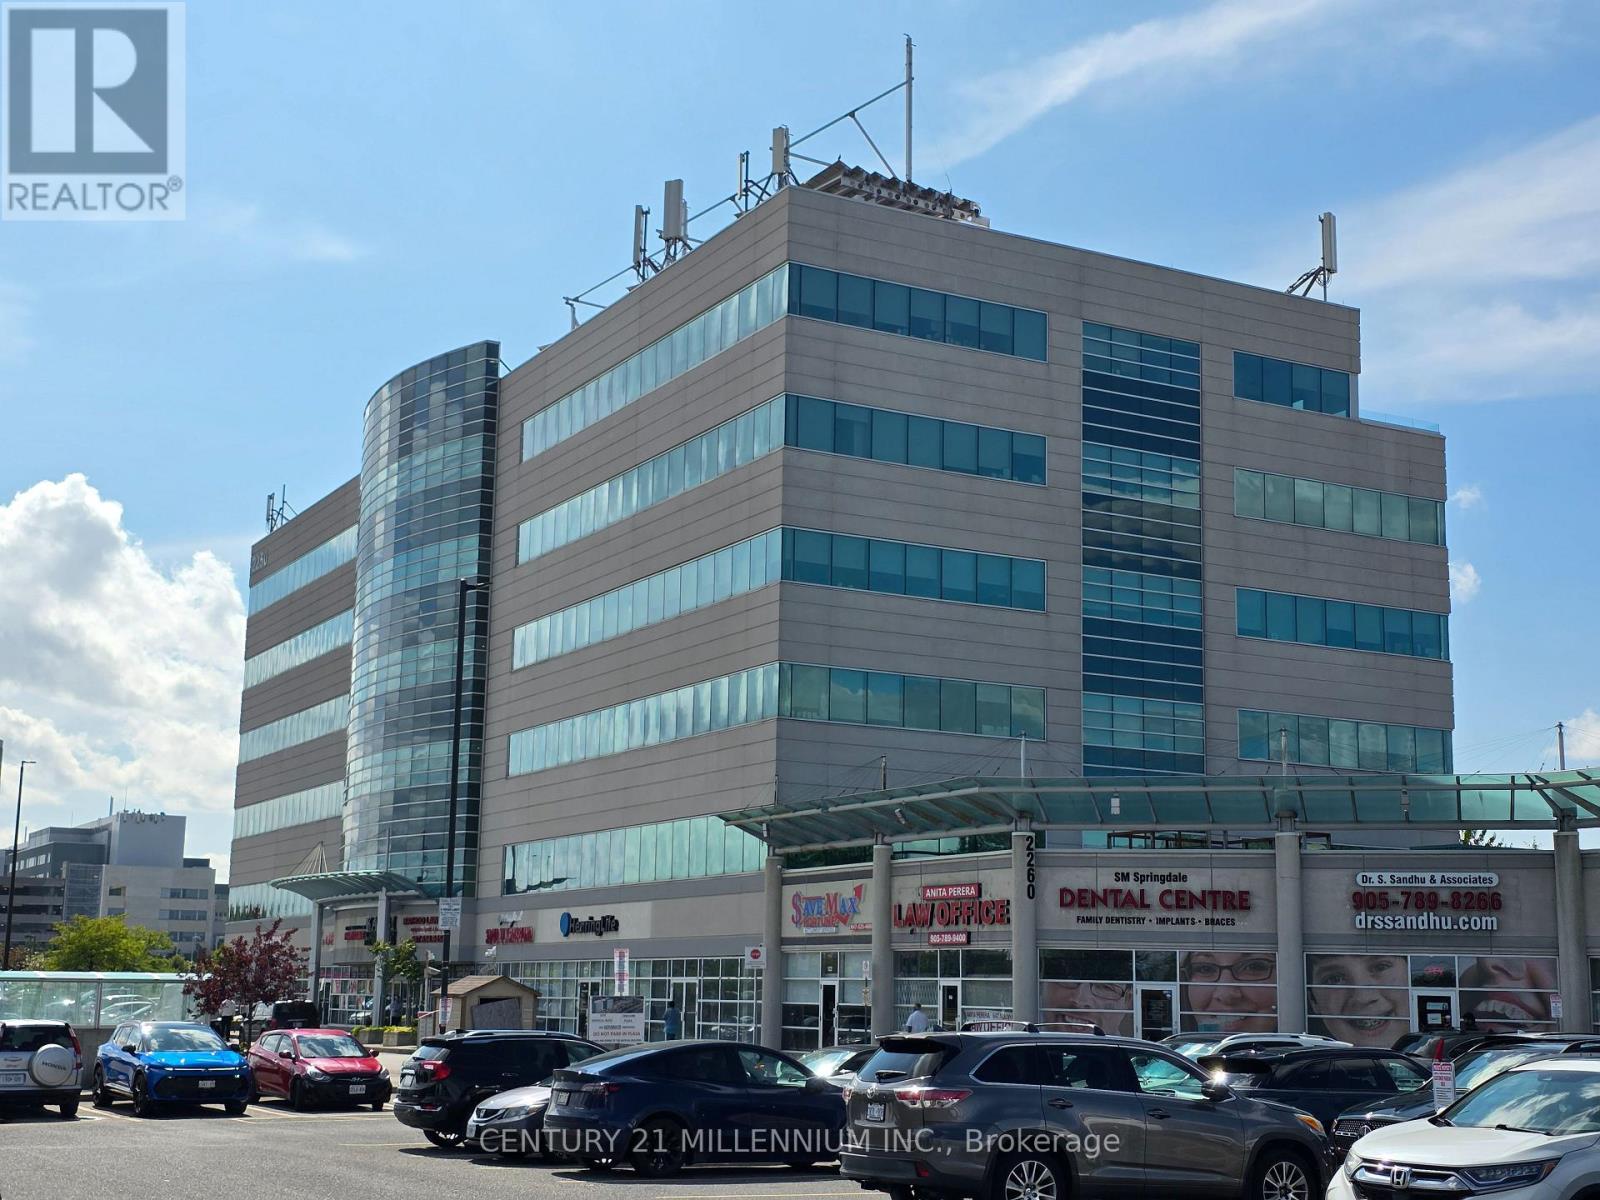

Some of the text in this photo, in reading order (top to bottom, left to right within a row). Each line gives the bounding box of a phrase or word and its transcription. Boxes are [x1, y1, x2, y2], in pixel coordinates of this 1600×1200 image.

[1025, 835, 1036, 900] 2260
[1114, 872, 1188, 885] SM Springdale
[1361, 874, 1494, 885] Dr. S. Sandhu & Associates
[926, 886, 976, 898] ANITA PERERA
[1059, 887, 1251, 911] DENTAL CENTRE
[1352, 891, 1503, 911] 905-789-8266
[892, 899, 1009, 929] LAW OFFICE
[1076, 915, 1236, 926] FAMILY DENTISTRY IMPLANTS BRACES
[1355, 911, 1499, 930] drssandhu.com
